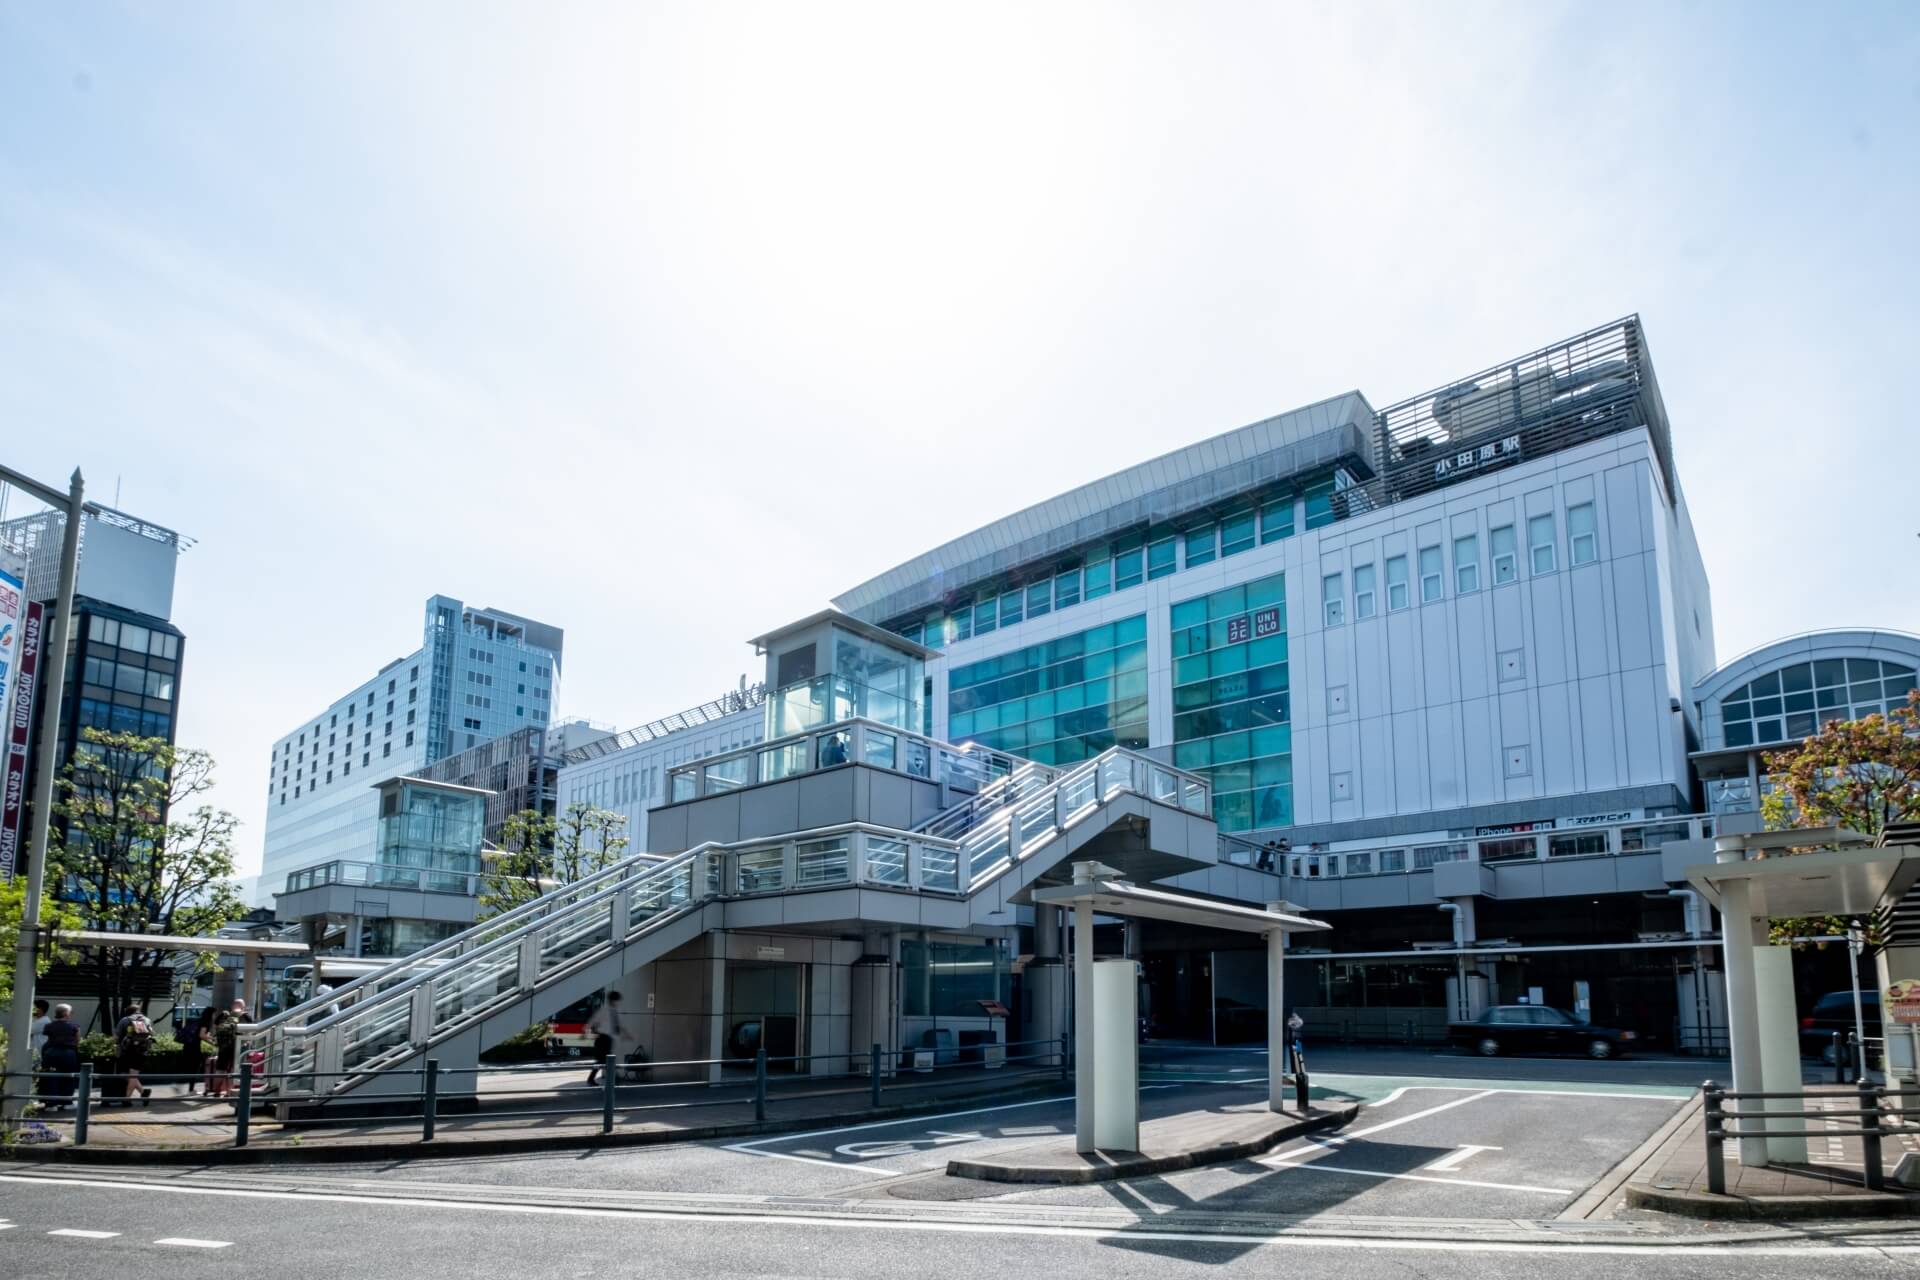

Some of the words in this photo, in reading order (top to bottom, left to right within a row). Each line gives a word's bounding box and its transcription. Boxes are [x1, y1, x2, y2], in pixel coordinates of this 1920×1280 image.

[1435, 435, 1520, 474] 小田原駅
[25, 617, 39, 656] カラオケ
[1257, 611, 1274, 623] UNI
[1257, 621, 1276, 633] QLO
[16, 671, 32, 728] JOYSOUND
[7, 770, 20, 811] カラオケ
[0, 826, 15, 883] JOYSOUN
